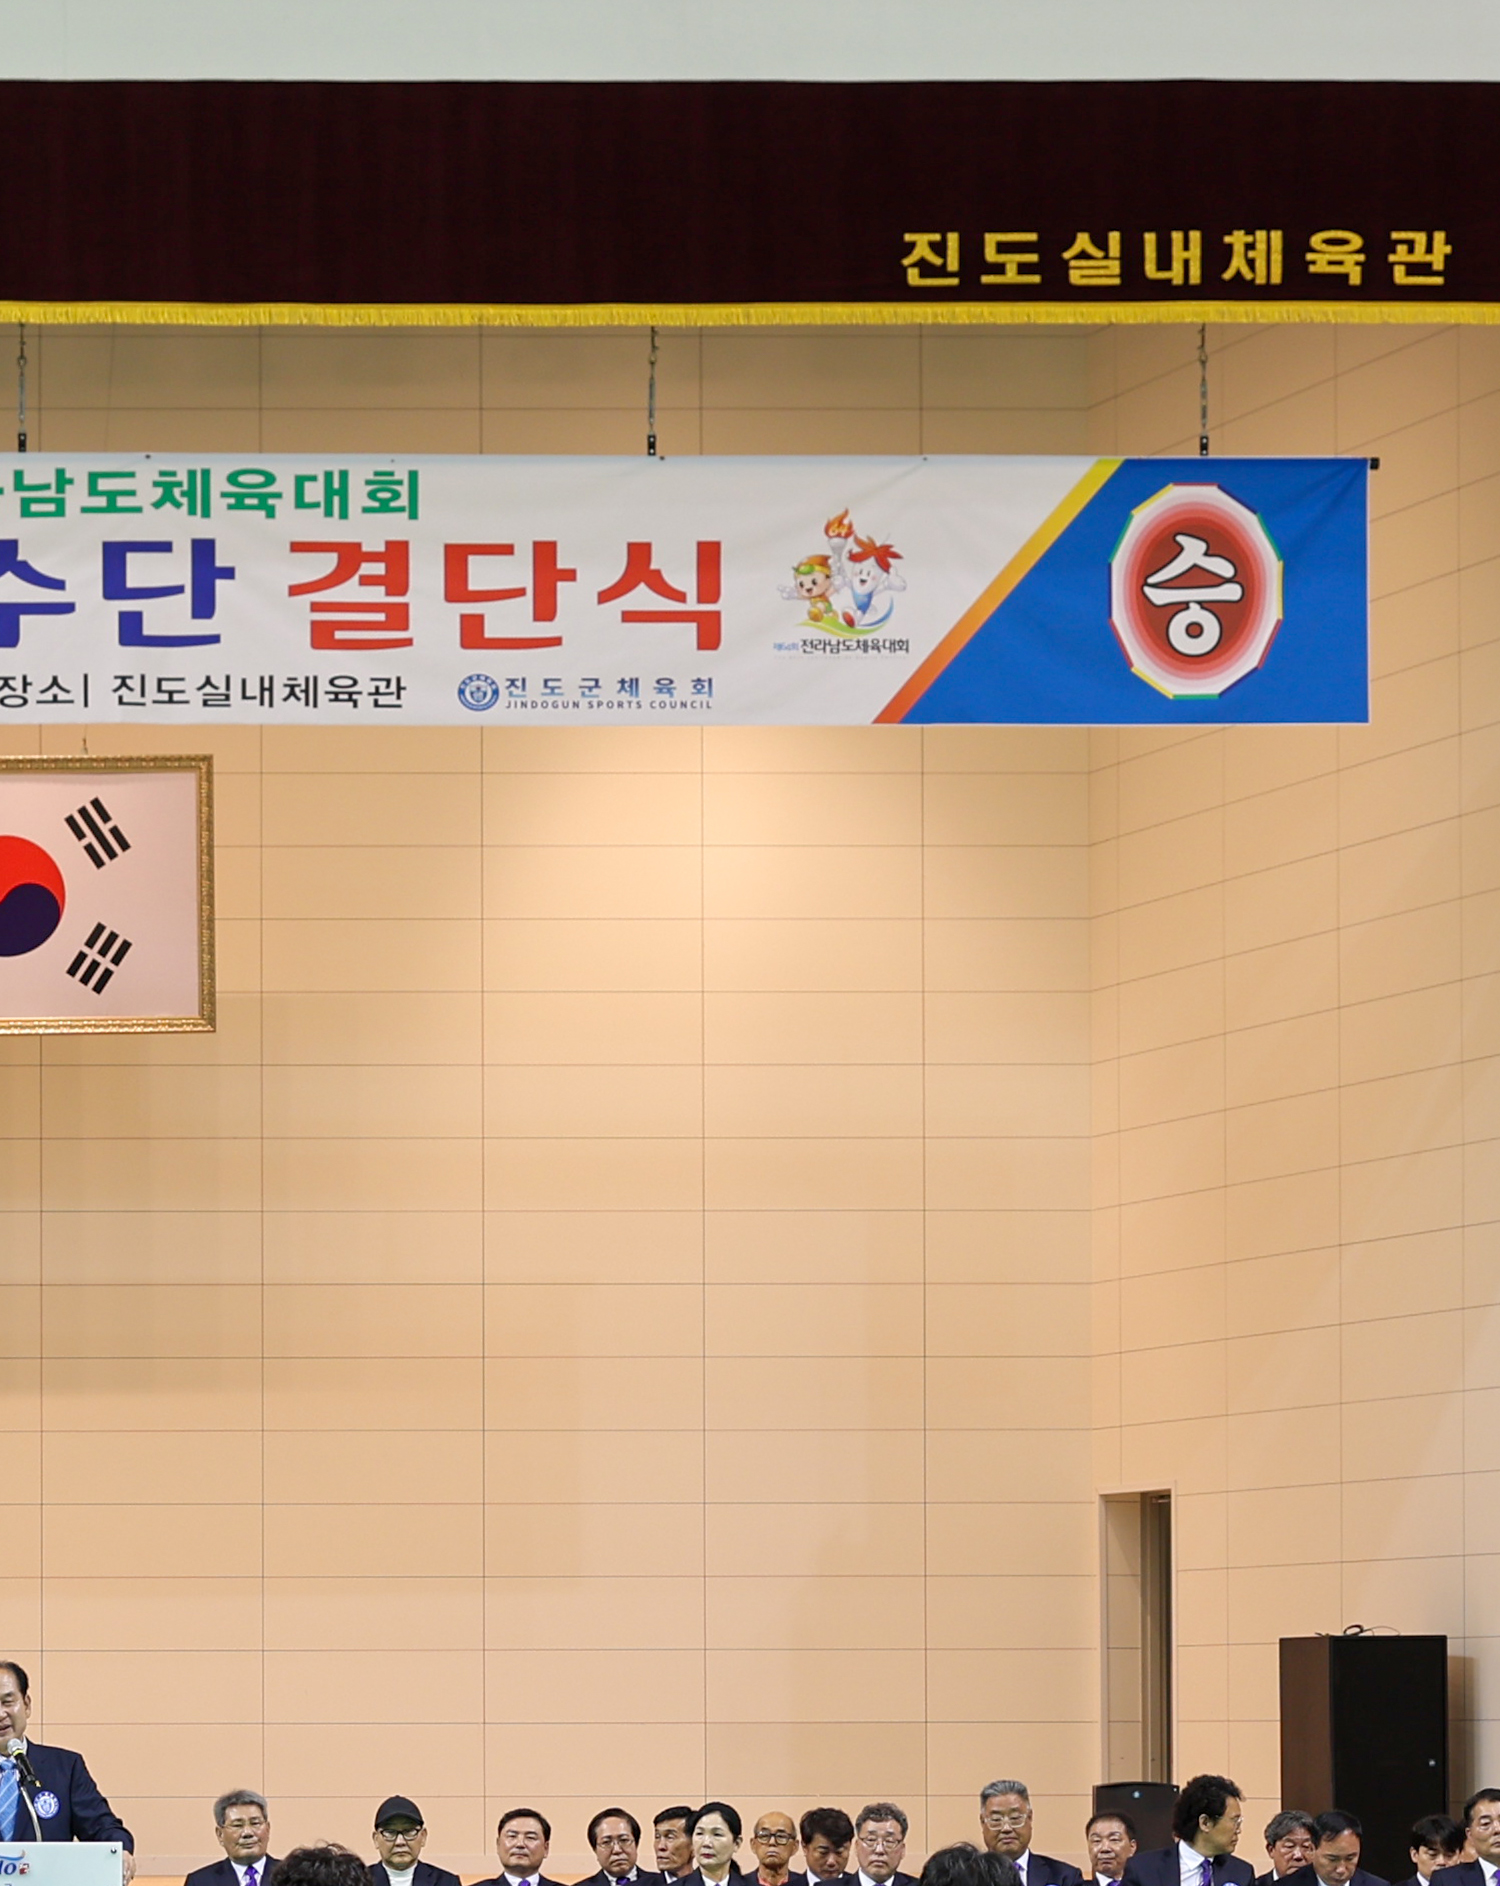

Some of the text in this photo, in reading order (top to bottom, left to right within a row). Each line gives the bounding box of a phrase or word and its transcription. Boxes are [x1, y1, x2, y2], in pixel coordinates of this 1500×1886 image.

[900, 230, 1454, 287] 진도실내체육관
[288, 540, 723, 652] 결단식
[1142, 532, 1244, 657] 승
[801, 639, 910, 654] 전라남도체육대회
[112, 674, 409, 711] 진도실내체육관
[505, 677, 714, 698] 진도군체육회
[505, 701, 713, 710] JINDOGUN SPORTS COUNCIL
